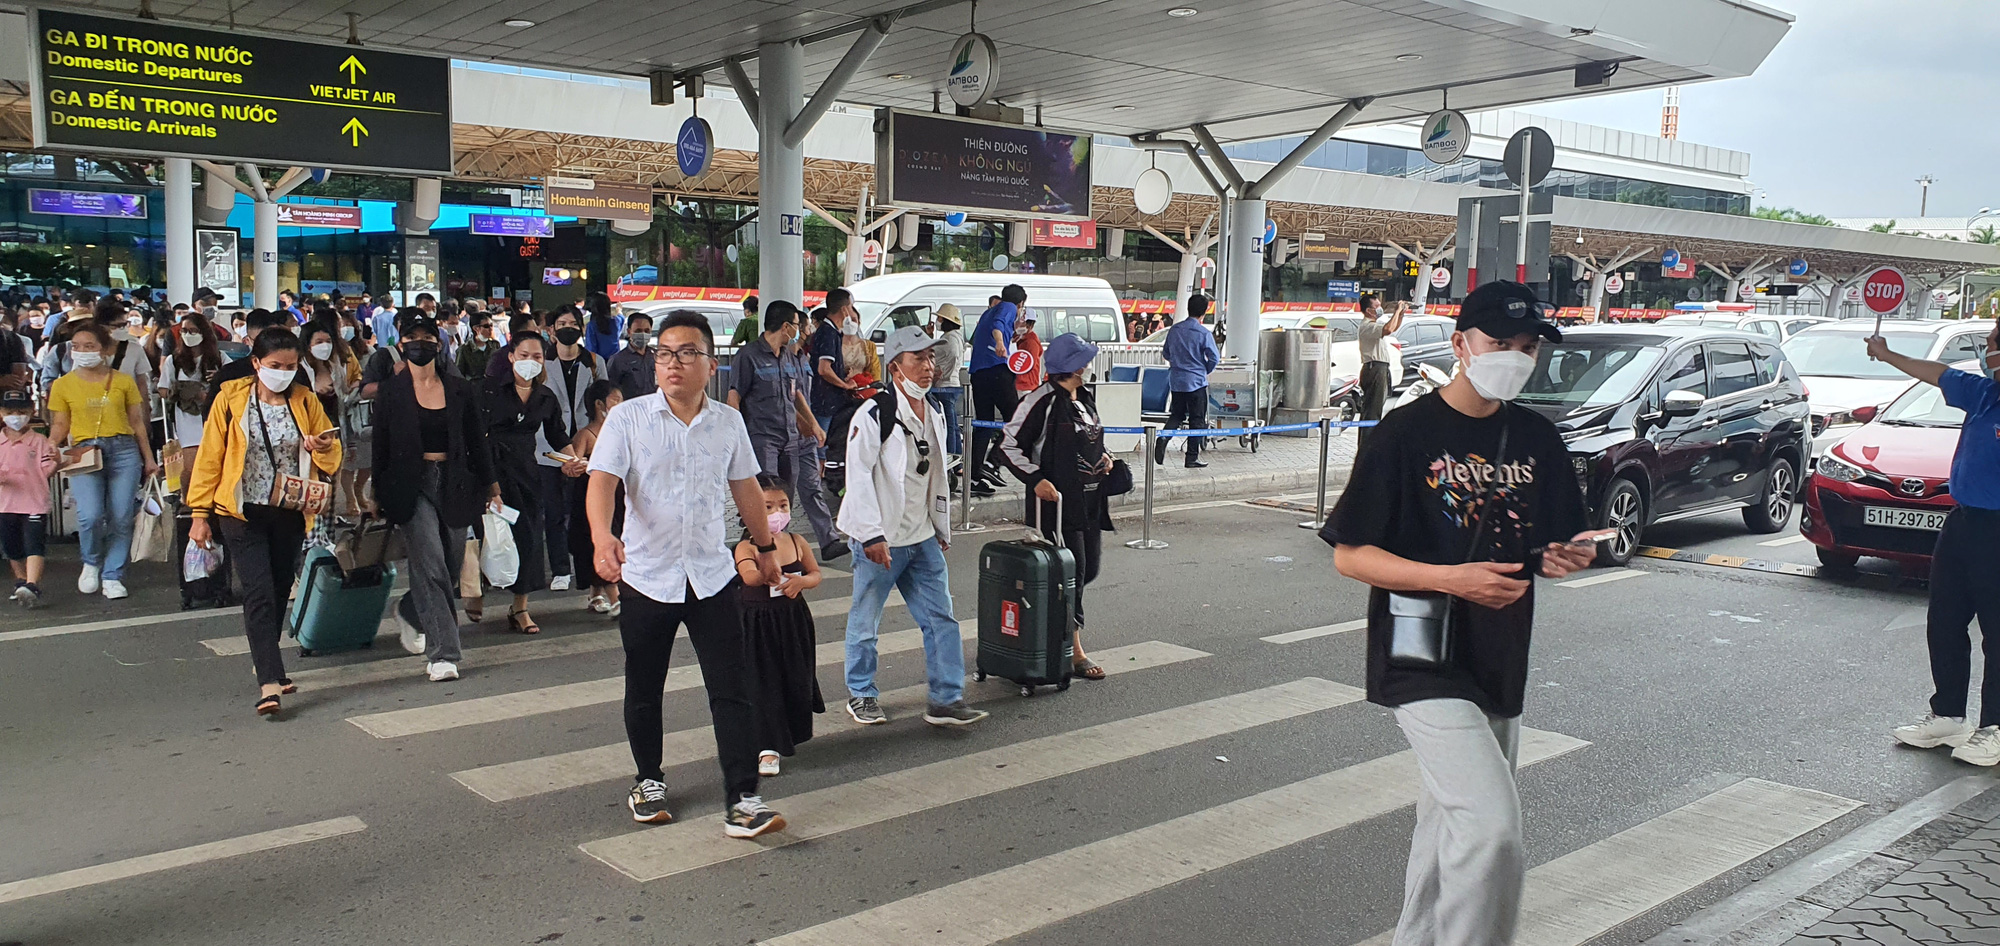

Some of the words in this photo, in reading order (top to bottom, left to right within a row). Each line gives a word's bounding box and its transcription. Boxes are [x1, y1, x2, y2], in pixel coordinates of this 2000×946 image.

[46, 28, 79, 47] GA
[85, 32, 108, 50] ĐI
[112, 35, 189, 59] TRONG
[195, 45, 253, 66] NƯỚC
[48, 50, 139, 74] Domestic
[144, 60, 243, 84] Departures
[948, 75, 979, 87] BAMBOO
[309, 84, 370, 101] VIETJET
[372, 91, 396, 104] AIR
[50, 88, 83, 106] GA
[88, 88, 136, 111] ĐẾN
[141, 97, 215, 118] TRONG
[221, 104, 278, 123] NƯỚC
[51, 110, 142, 132] Domestic
[146, 119, 217, 138] Arrivals
[963, 137, 992, 151] THIÊN
[994, 141, 1028, 155] ĐƯỜNG
[1424, 140, 1457, 150] BAMBOO
[959, 153, 1003, 171] KHÔNG
[550, 193, 606, 208] Homtamin
[607, 198, 650, 213] Ginseng
[1866, 282, 1902, 299] STOP
[1013, 352, 1028, 372] STOP
[1867, 509, 1945, 530] 51H-297.82
